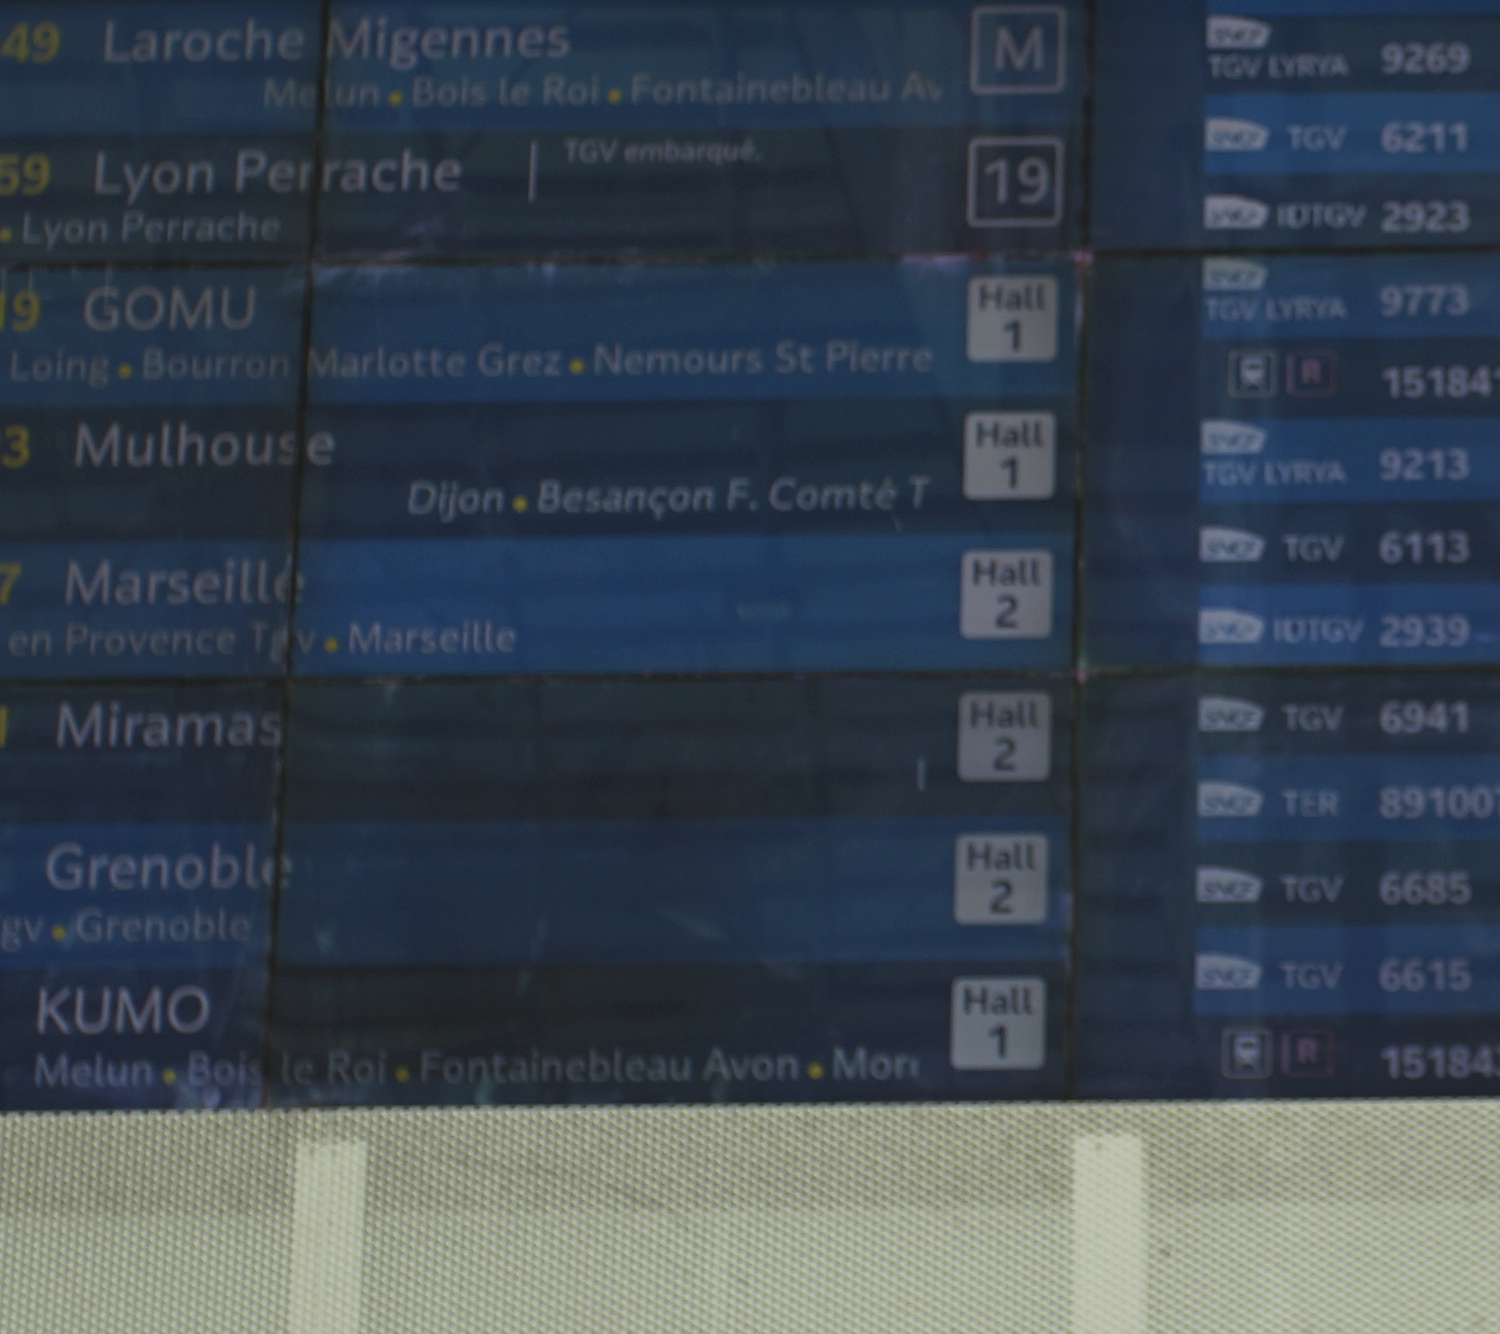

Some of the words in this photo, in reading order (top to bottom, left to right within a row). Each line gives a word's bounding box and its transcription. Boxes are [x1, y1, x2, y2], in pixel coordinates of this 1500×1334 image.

[103, 18, 303, 62] Laroche
[327, 16, 570, 66] Migennes
[994, 24, 1045, 72] M
[1381, 42, 1470, 72] 9269
[412, 76, 486, 107] Bois
[543, 74, 600, 106] Roi
[630, 70, 890, 104] Fontainebleau
[564, 137, 617, 165] TGV
[1381, 121, 1469, 152] 6211
[94, 150, 214, 205] Lyon
[236, 148, 461, 193] Perrache
[983, 154, 1050, 204] 19
[23, 212, 107, 249] Lyon
[121, 209, 280, 242] Perrache
[1381, 200, 1470, 231] 2923
[84, 284, 257, 331] GOMU
[978, 282, 1046, 312] Hall
[1381, 284, 1470, 316] 9773
[1002, 320, 1023, 352] 1
[11, 349, 109, 388] Loing
[142, 347, 288, 381] Bourron
[308, 344, 464, 378] Marlotte
[479, 342, 561, 378] Grez
[594, 341, 763, 374] Nemours
[776, 339, 815, 373] St
[827, 339, 933, 373] Pierre
[74, 422, 335, 468] Mulhouse
[975, 419, 1043, 449] Hall
[1001, 456, 1021, 488] 1
[1380, 448, 1470, 481] 9213
[408, 481, 503, 521] Dijon
[537, 477, 714, 520] Besançon
[727, 477, 758, 511] F.
[769, 476, 895, 511] Comté
[1380, 529, 1470, 562] 6113
[972, 557, 1040, 586] Hall
[995, 595, 1018, 628] 2
[9, 630, 51, 656] en
[66, 621, 236, 655] Provence
[248, 621, 314, 661] Tgv
[348, 621, 516, 653] Marseille
[1380, 614, 1470, 646] 2939
[56, 700, 283, 748] Miramas
[969, 700, 1038, 730] Hall
[1380, 699, 1469, 732] 6941
[993, 737, 1015, 771] 2
[966, 841, 1034, 871] Hall
[990, 879, 1012, 913] 2
[1379, 871, 1471, 903] 6685
[1379, 956, 1471, 989] 6615
[37, 985, 209, 1034] KUMO
[963, 986, 1032, 1016] Hall
[990, 1024, 1008, 1058] 1
[34, 1052, 154, 1088] Melun
[188, 1052, 262, 1087] Bois
[327, 1048, 387, 1083] Roi
[421, 1046, 691, 1083] Fontainebleau
[708, 1046, 797, 1081] Avon
